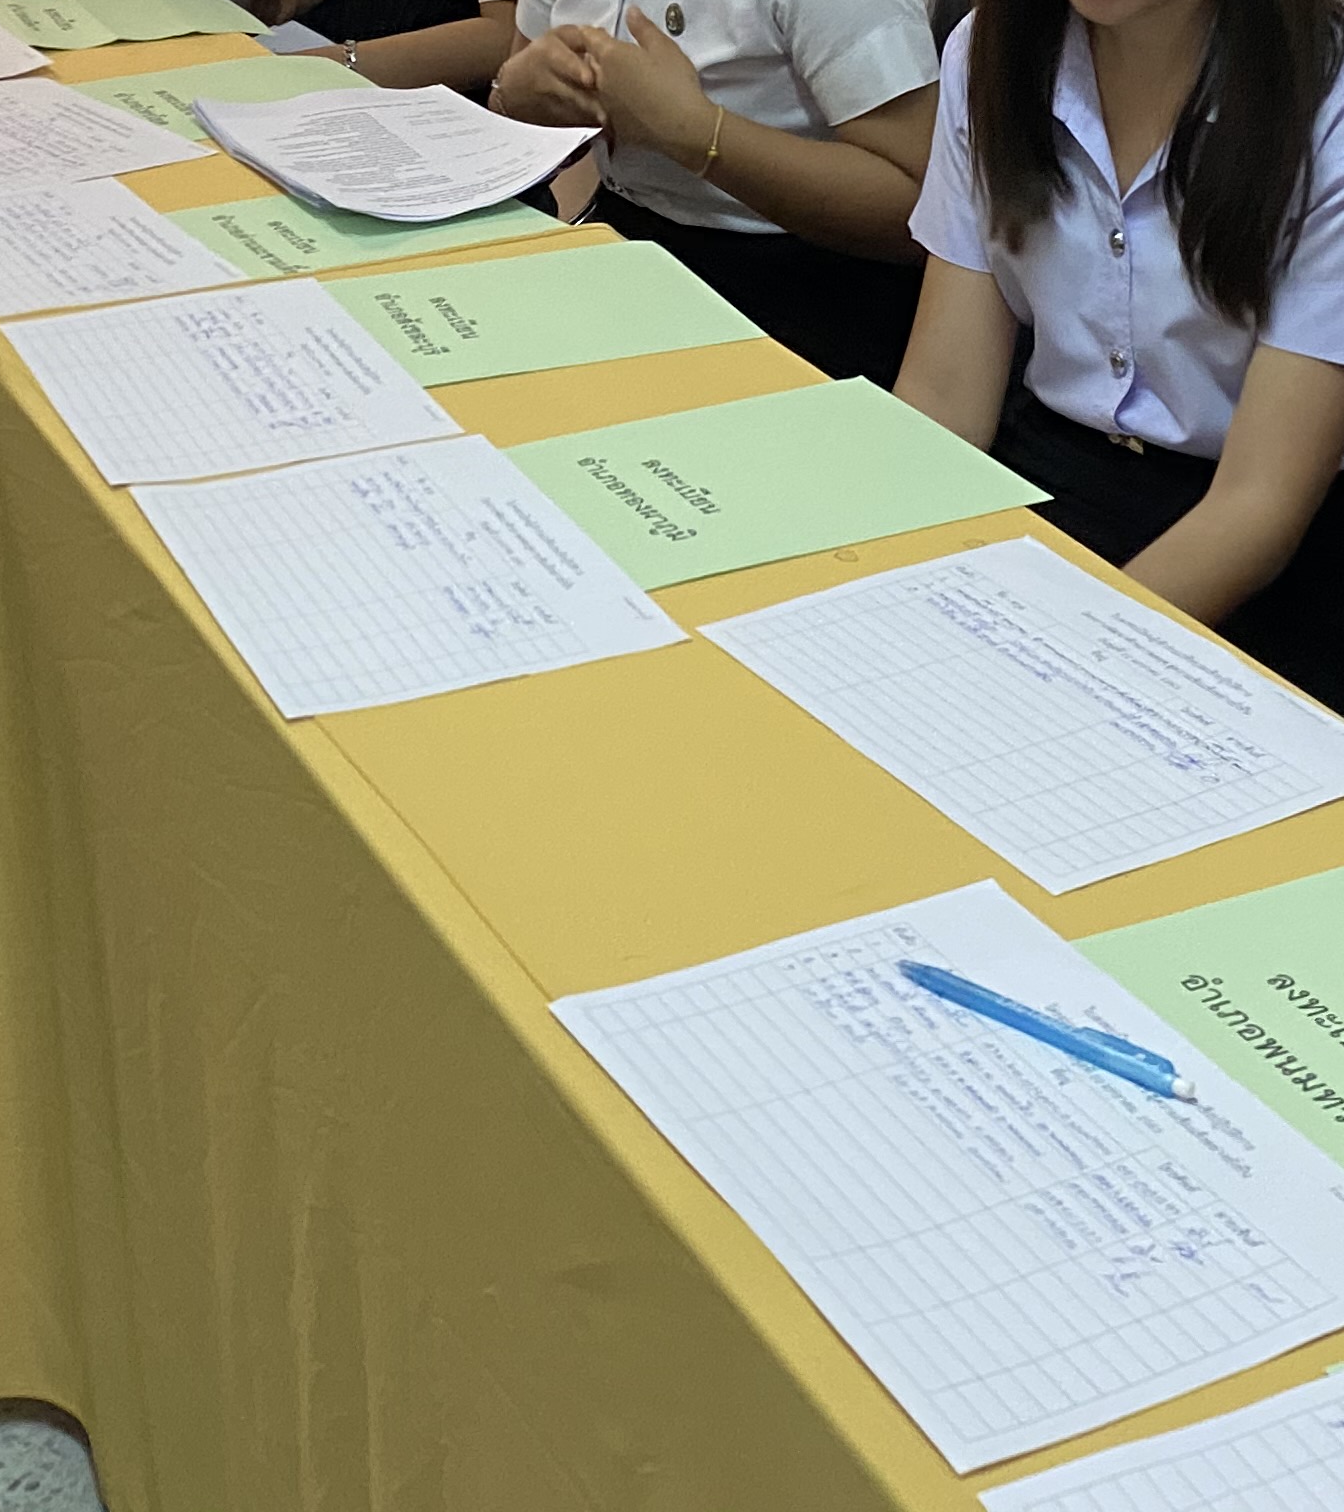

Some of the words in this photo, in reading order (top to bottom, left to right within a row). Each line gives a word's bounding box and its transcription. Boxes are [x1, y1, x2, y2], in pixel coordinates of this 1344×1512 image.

[428, 296, 480, 340] ลงทะเบียน
[576, 455, 699, 544] อำเภอทองผาภูมิ
[641, 456, 723, 517] ลงทะเบียน
